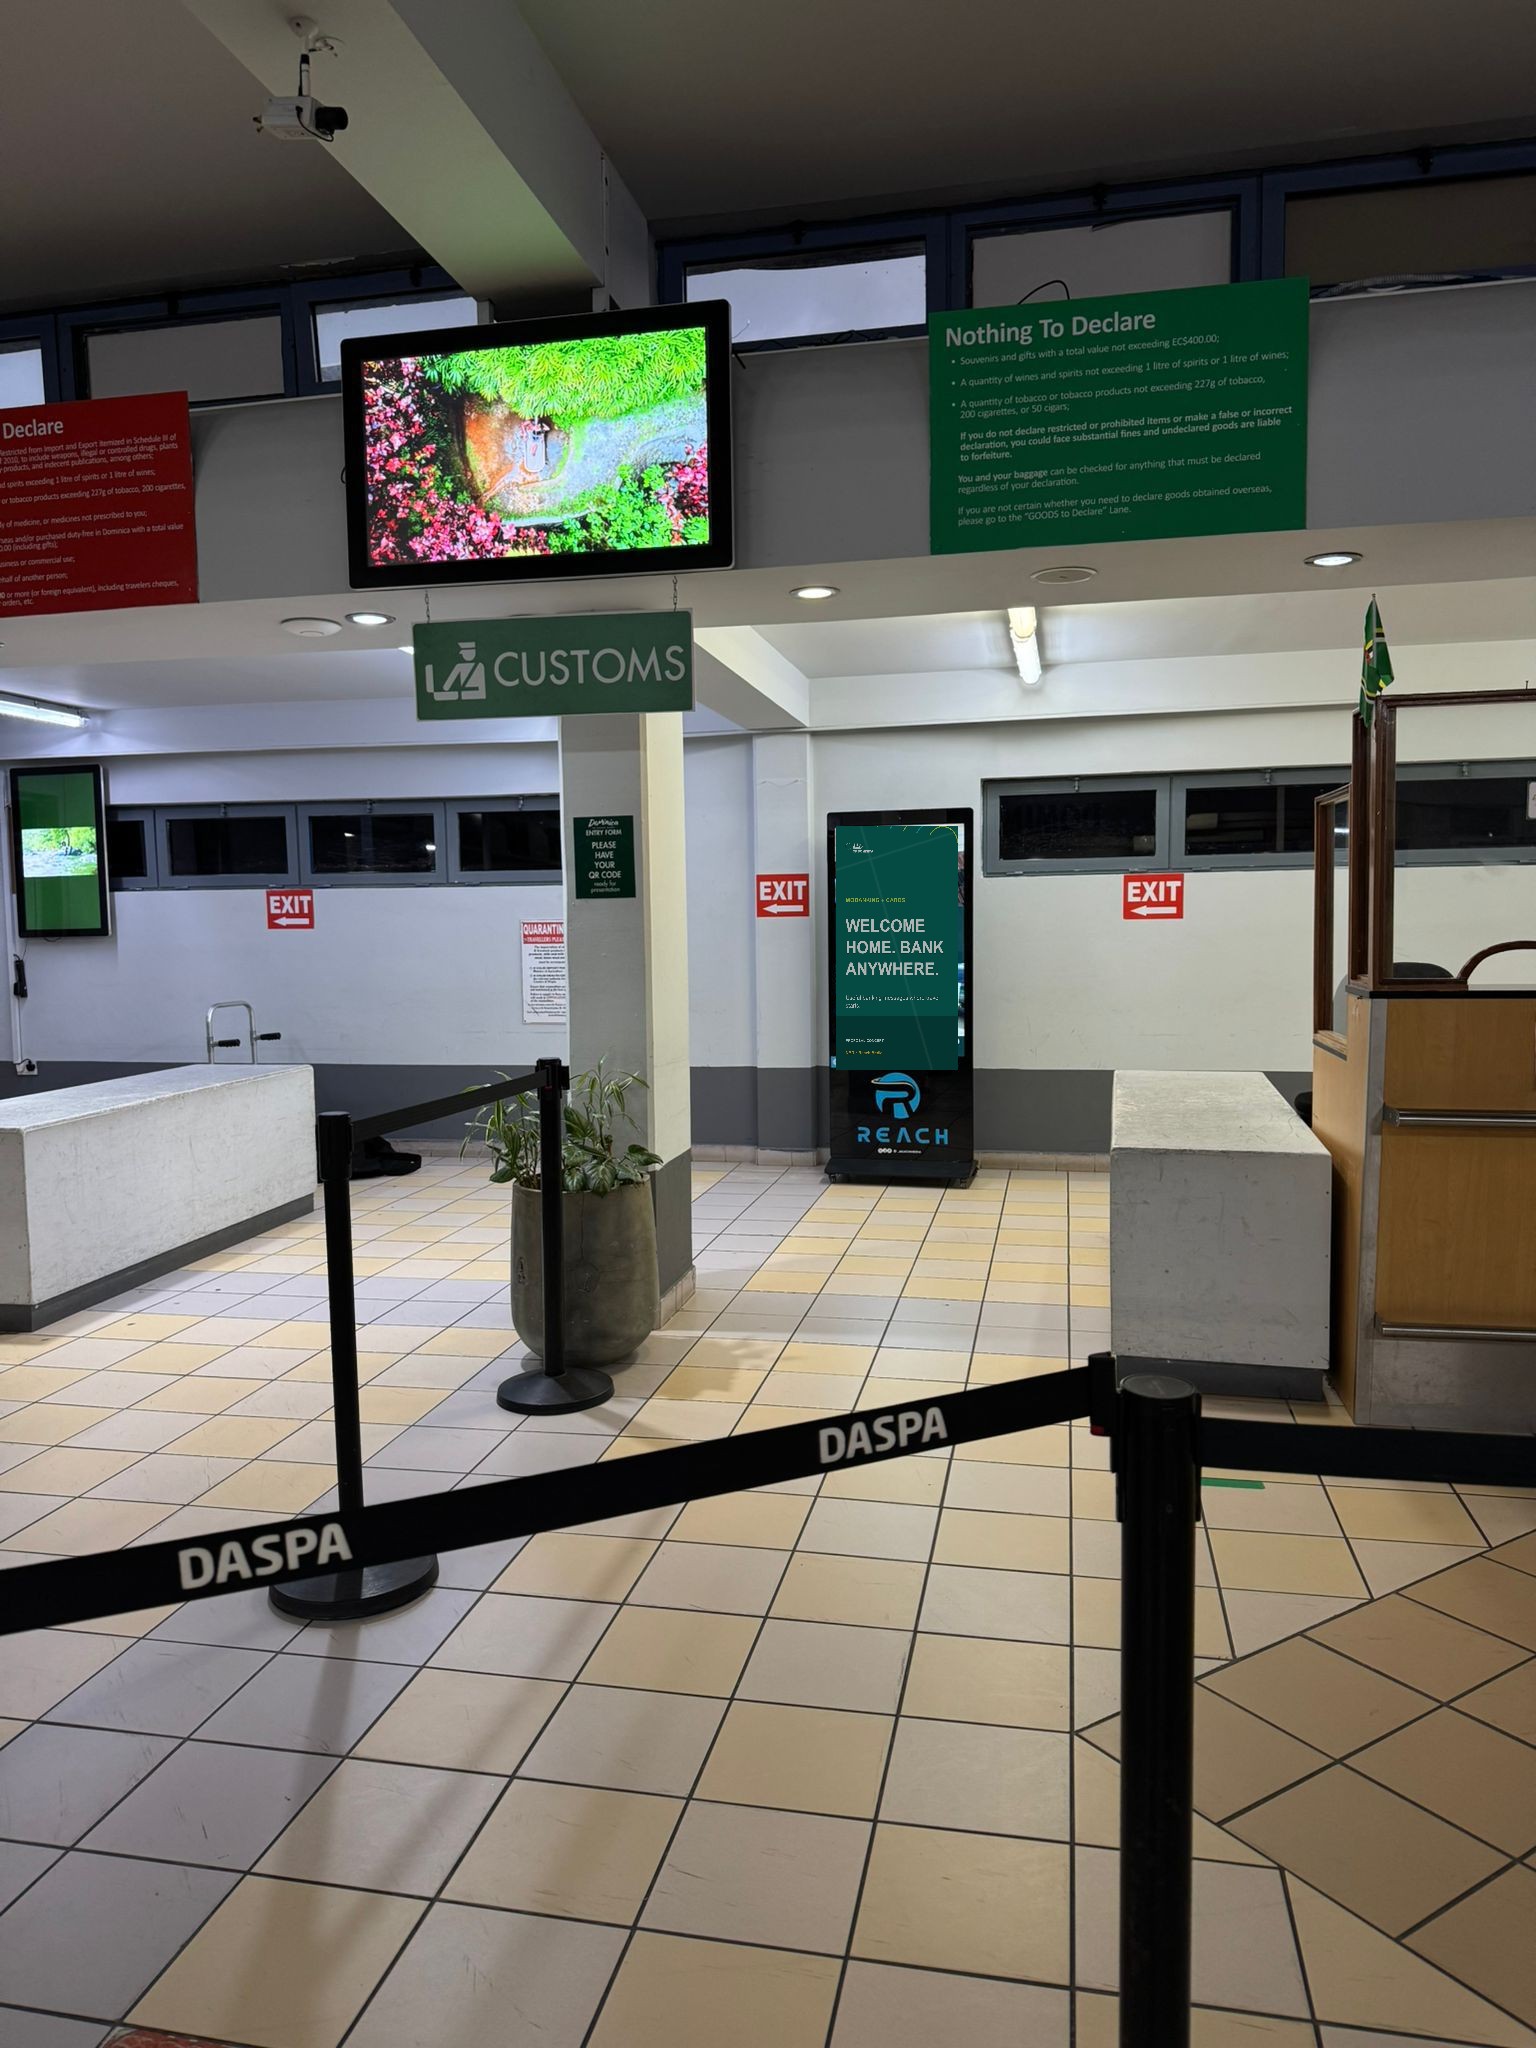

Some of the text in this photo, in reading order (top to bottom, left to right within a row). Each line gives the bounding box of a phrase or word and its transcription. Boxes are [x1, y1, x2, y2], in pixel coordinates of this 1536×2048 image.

[946, 312, 1155, 347] Nothing To Declare
[960, 355, 999, 365] Souvenirs
[1001, 353, 1016, 361] and
[1019, 351, 1036, 361] gifts
[1038, 349, 1056, 358] with
[1066, 346, 1085, 355] total
[1087, 345, 1109, 353] value
[1128, 340, 1170, 350] exceeding
[969, 377, 1002, 386] quantity
[1004, 374, 1013, 383] of
[1041, 371, 1056, 379] and
[1059, 370, 1083, 379] spirits
[1102, 364, 1143, 374] exceeding
[1172, 360, 1180, 368] of
[1183, 359, 1208, 368] spirits
[1250, 352, 1258, 361] of
[961, 400, 967, 408] A
[969, 398, 1002, 408] quantity
[1004, 396, 1012, 404] of
[1015, 395, 1047, 403] tobacco
[1061, 391, 1093, 399] tobacco
[1095, 387, 1131, 397] products
[1150, 382, 1192, 392] exceeding
[1195, 379, 1215, 389] 227g
[1218, 377, 1226, 386] of
[960, 410, 975, 418] 200
[1032, 404, 1042, 413] 50
[3, 419, 63, 439] Declare
[961, 432, 966, 440] If
[986, 430, 996, 438] do
[1015, 427, 1045, 435] declare
[1048, 422, 1087, 432] restricted
[1101, 418, 1144, 429] prohibited
[1185, 413, 1208, 421] make
[1219, 410, 1239, 418] false
[1254, 406, 1291, 416] incorrect
[1011, 440, 1026, 448] you
[1029, 436, 1050, 445] could
[1053, 435, 1070, 443] face
[1073, 431, 1118, 441] substantial
[1143, 427, 1159, 436] and
[1162, 423, 1209, 434] undeclared
[1212, 421, 1238, 432] goods
[1257, 417, 1280, 426] liable
[975, 473, 990, 481] and
[993, 473, 1012, 481] your
[1014, 470, 1047, 479] baggage
[1080, 464, 1112, 473] checked
[1130, 461, 1165, 470] anything
[1224, 452, 1260, 462] declared
[958, 484, 998, 495] regardless
[1000, 482, 1008, 490] of
[1011, 482, 1029, 491] your
[966, 508, 980, 516] you
[1044, 499, 1078, 508] whether
[1098, 495, 1118, 504] need
[1133, 493, 1162, 501] declare
[1165, 490, 1190, 501] goods
[1193, 487, 1230, 497] obtained
[958, 517, 983, 526] please
[985, 517, 996, 525] go
[494, 646, 685, 686] CUSTOMS
[588, 819, 619, 828] Dominica
[591, 841, 617, 849] PLEASE
[594, 851, 614, 859] HAVE
[594, 861, 615, 869] YOUR
[588, 871, 622, 879] QR CODE
[760, 880, 807, 901] EXIT
[1128, 880, 1182, 902] EXIT
[270, 895, 312, 914] EXIT
[523, 923, 564, 935] QUARANTIN
[846, 919, 925, 932] WELCOME
[847, 941, 943, 953] HOME. BANK
[846, 962, 938, 975] ANYWHERE.
[857, 1126, 949, 1145] REACH
[818, 1406, 949, 1464] DASPA
[178, 1521, 354, 1590] DASPA
